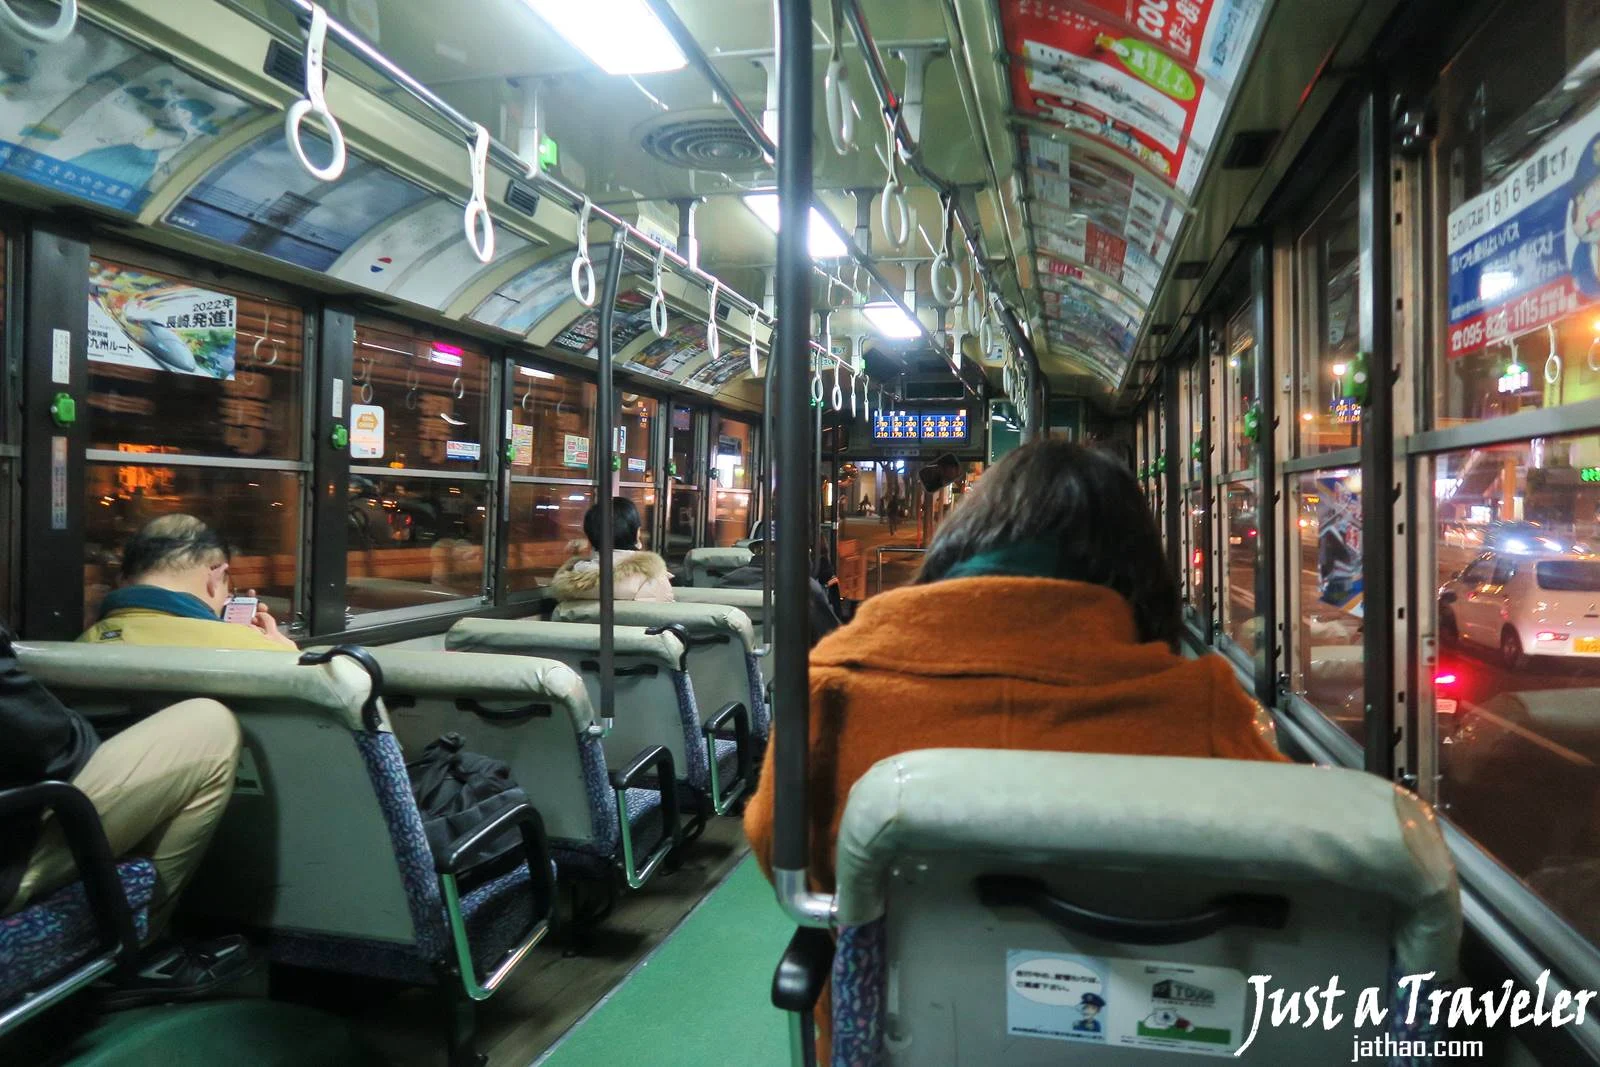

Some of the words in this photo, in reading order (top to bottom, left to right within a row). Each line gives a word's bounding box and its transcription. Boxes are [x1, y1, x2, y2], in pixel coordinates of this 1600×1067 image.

[193, 299, 232, 312] 2022年
[87, 337, 134, 353] 九州ルート
